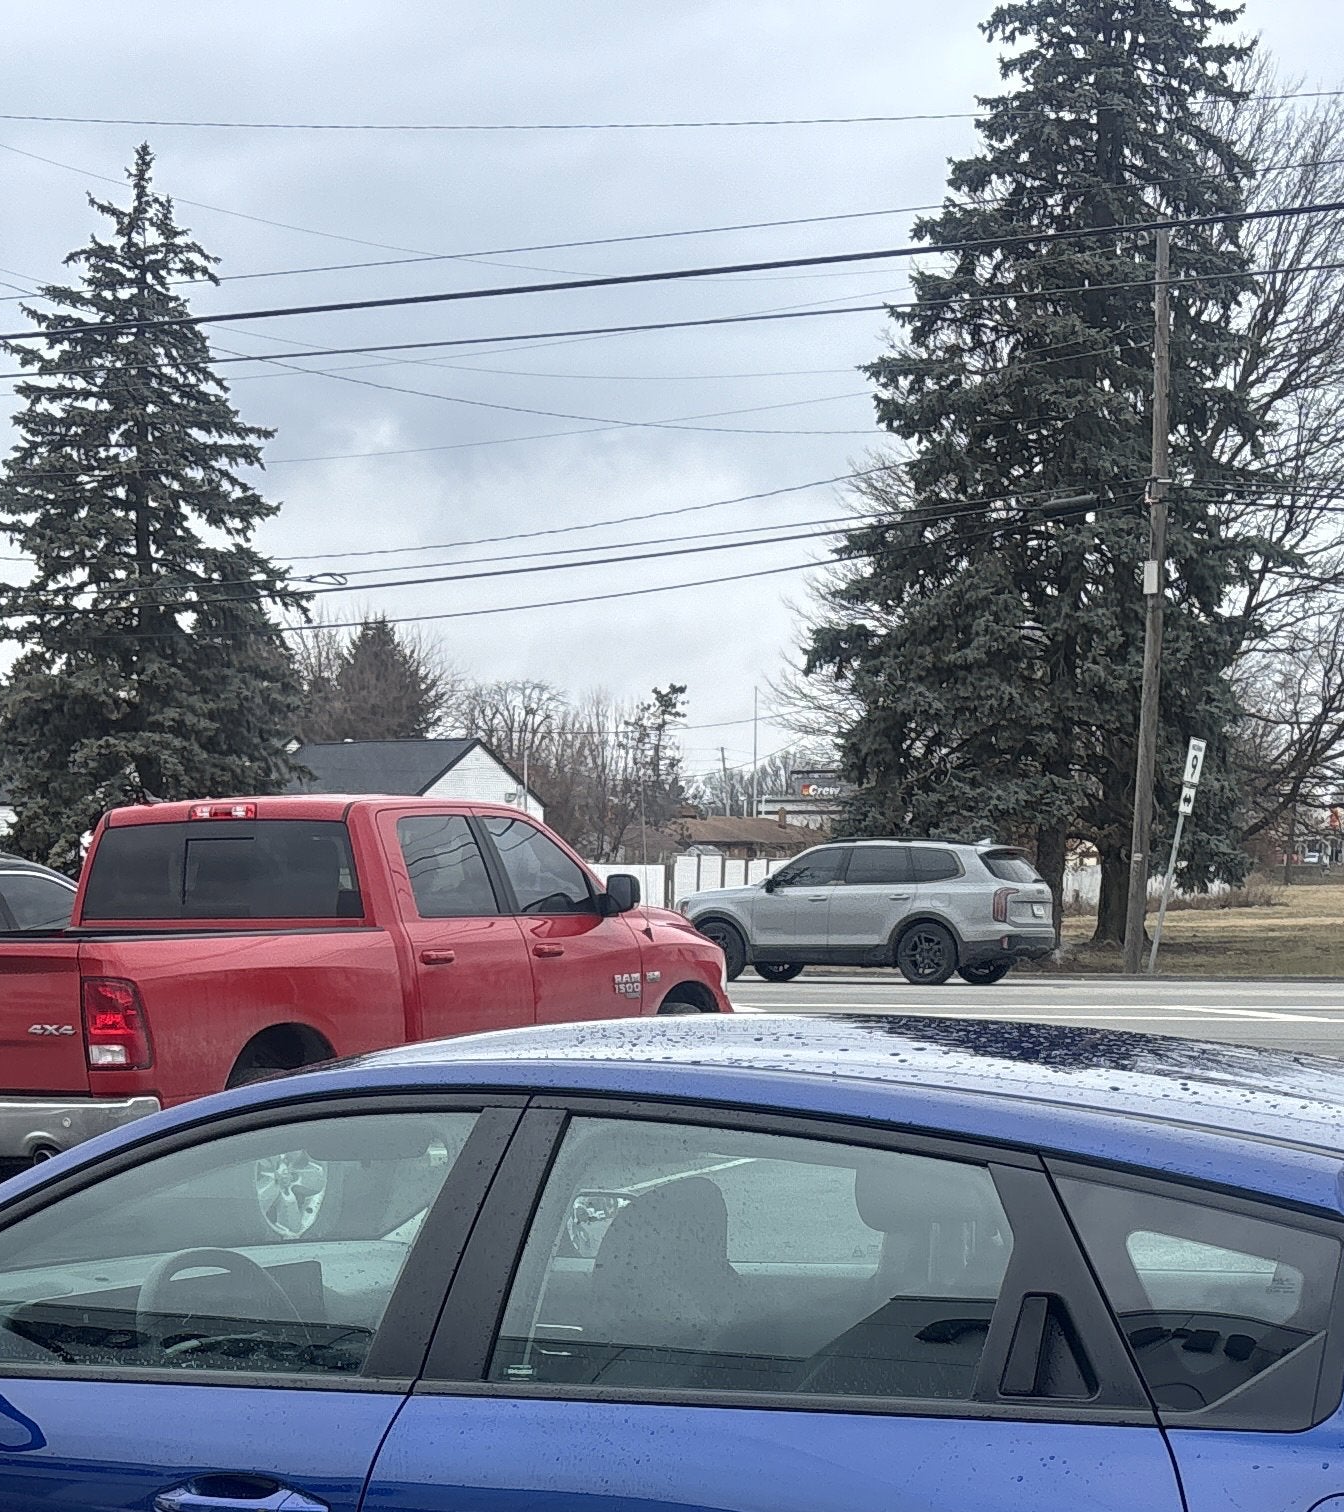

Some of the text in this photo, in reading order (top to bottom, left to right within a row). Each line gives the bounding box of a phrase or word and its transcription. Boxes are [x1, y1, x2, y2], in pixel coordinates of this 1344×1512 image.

[1191, 755, 1199, 779] 9
[614, 973, 640, 983] RAM
[615, 983, 641, 994] 1500
